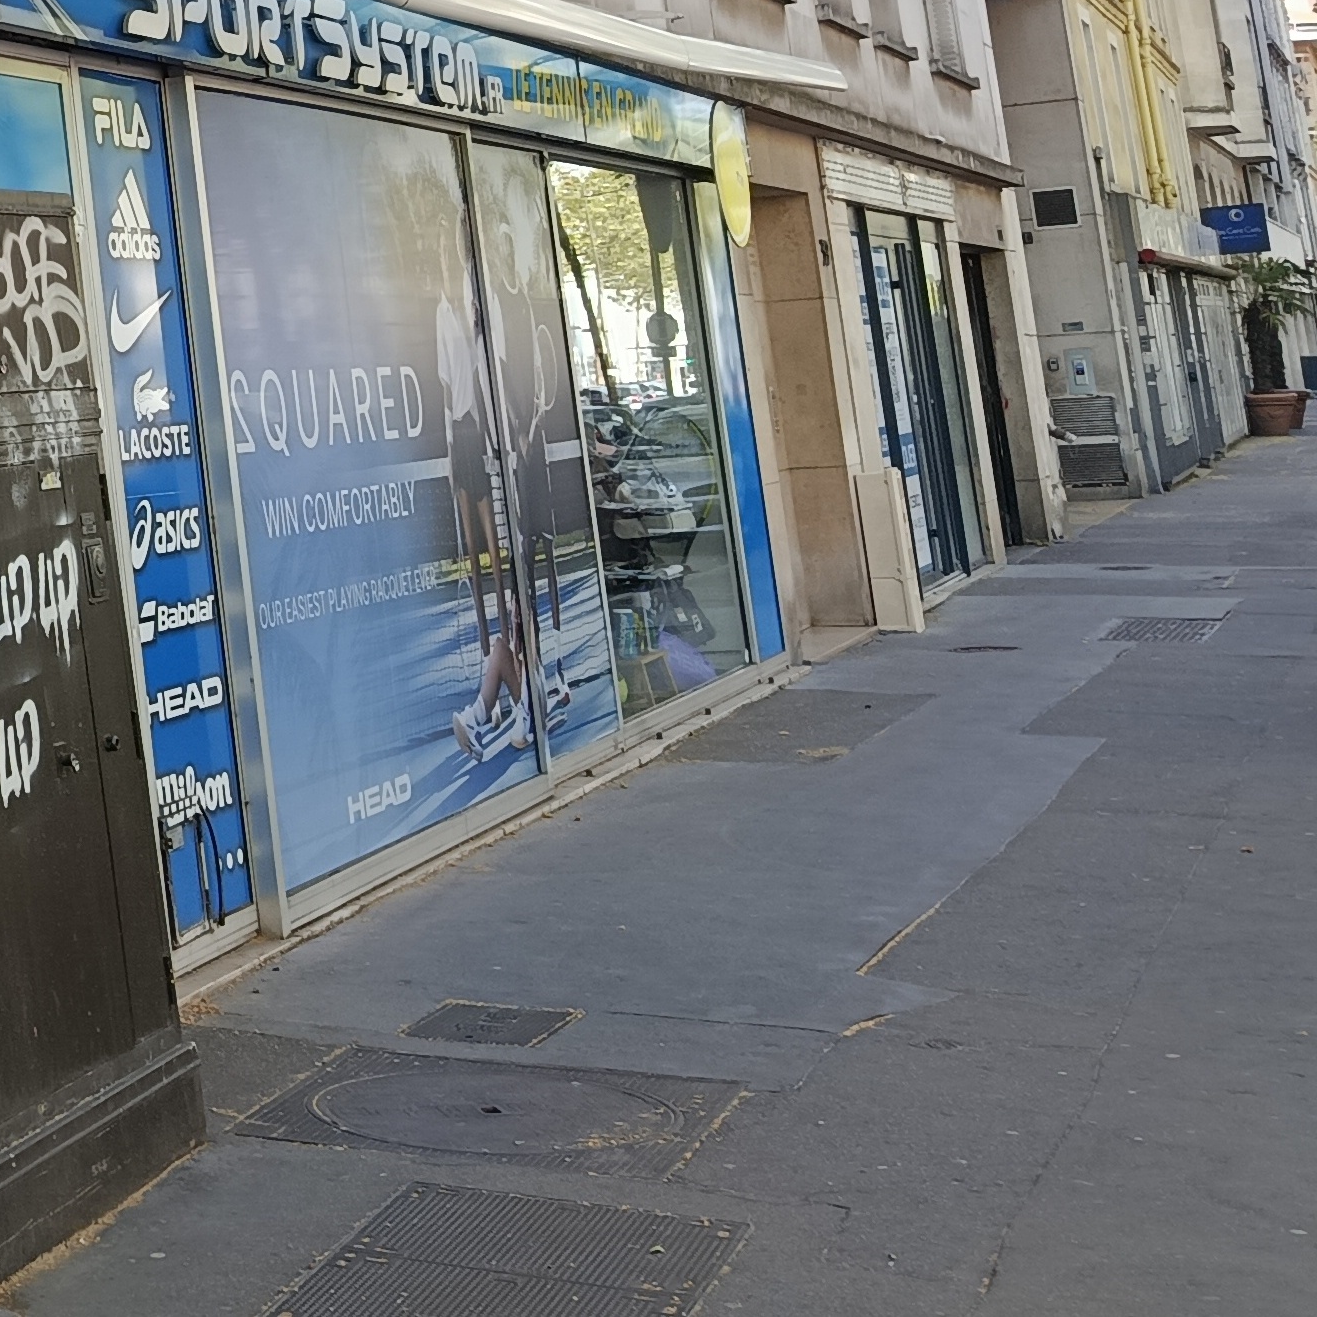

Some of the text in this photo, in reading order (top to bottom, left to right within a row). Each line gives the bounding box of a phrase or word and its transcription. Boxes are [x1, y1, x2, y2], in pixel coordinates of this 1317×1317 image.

[92, 96, 151, 150] FILA
[513, 64, 662, 142] LE TENNIS EN GRAND
[108, 227, 161, 261] adidas
[119, 424, 191, 461] LACOSTE
[262, 480, 415, 539] WIN COMFORTABLY
[259, 600, 284, 630] OUR
[285, 590, 326, 624] EASIEST
[328, 581, 370, 614] PLAYING
[371, 570, 413, 604] RACQUET
[147, 676, 224, 726] HEAD
[347, 769, 412, 824] HEAD
